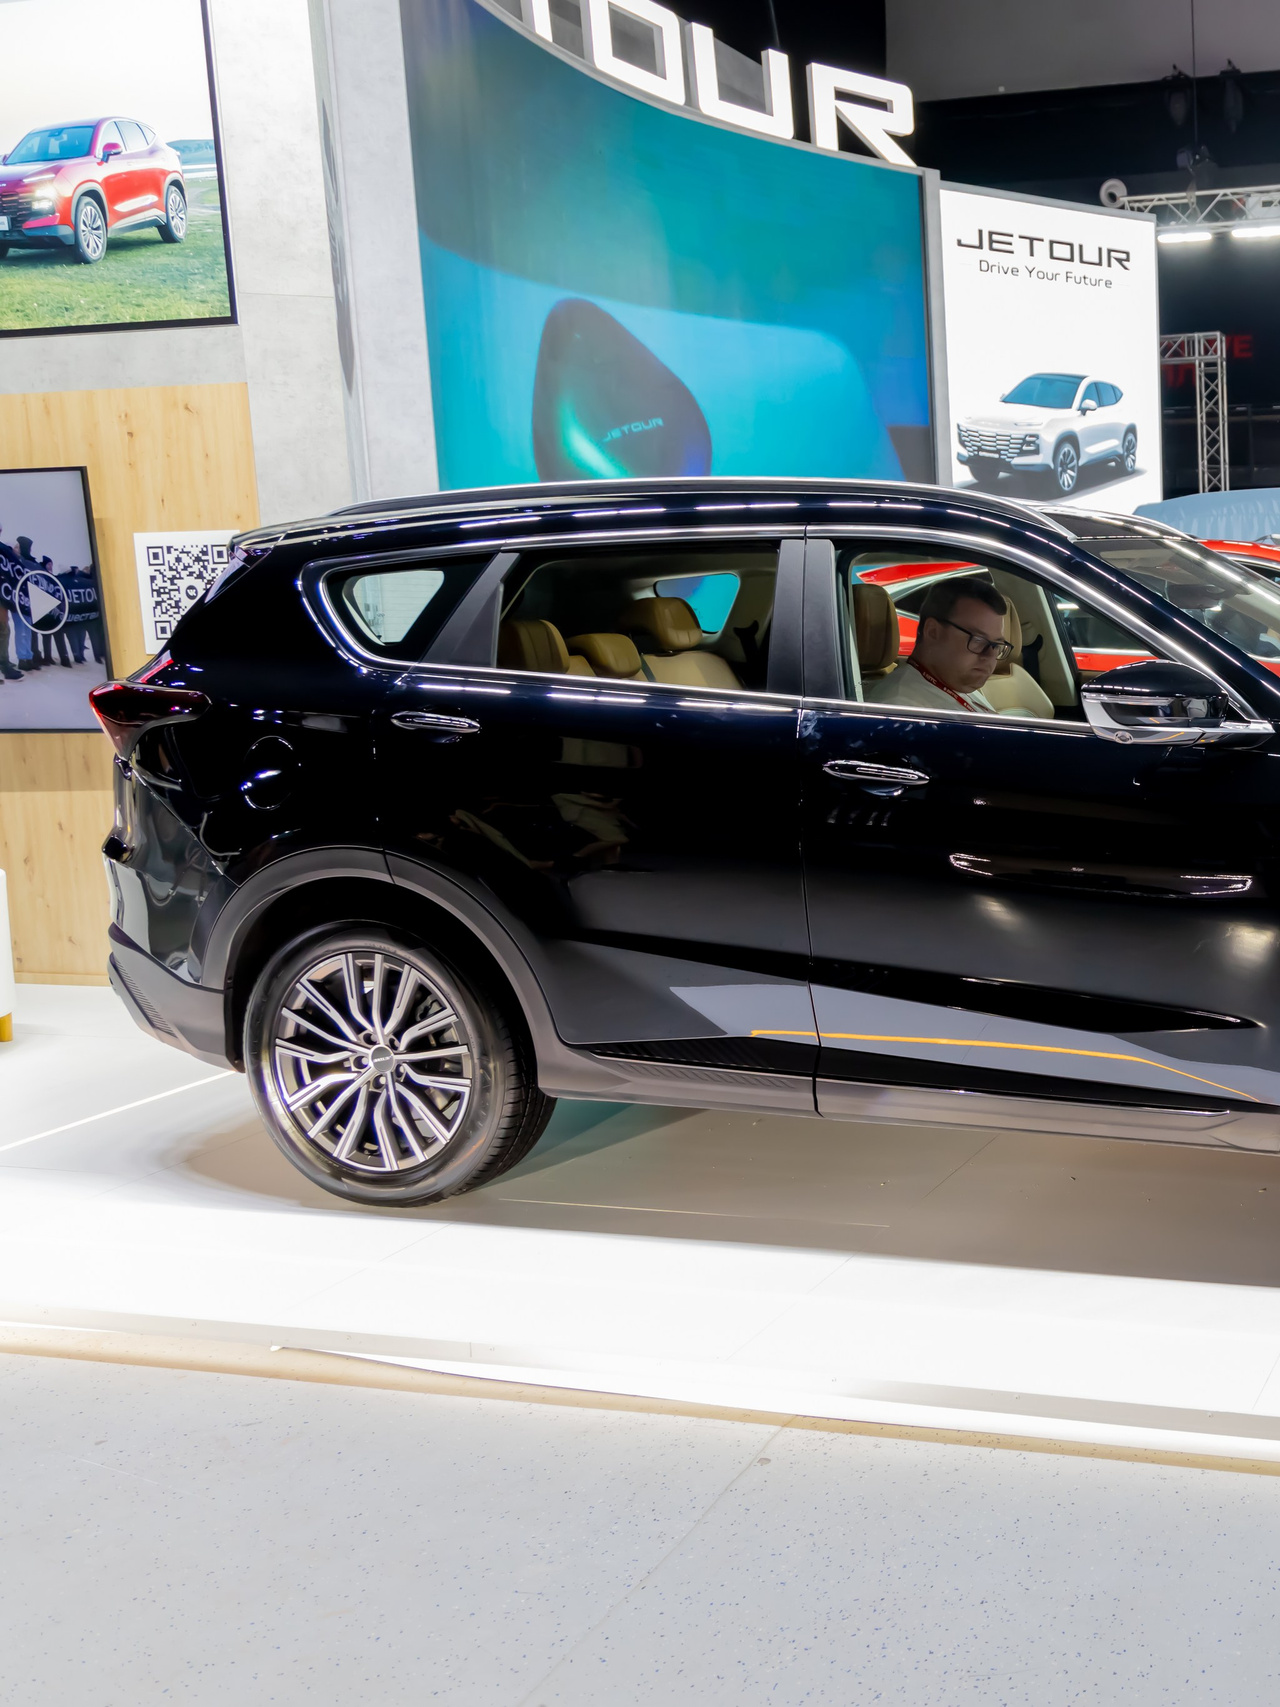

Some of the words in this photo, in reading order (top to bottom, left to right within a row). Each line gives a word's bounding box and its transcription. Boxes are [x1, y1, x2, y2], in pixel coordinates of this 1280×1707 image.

[956, 228, 1131, 271] JETOUR
[979, 259, 1020, 277] Drive
[1025, 265, 1060, 282] Your
[1065, 271, 1113, 289] Future
[602, 417, 664, 442] JETOUR
